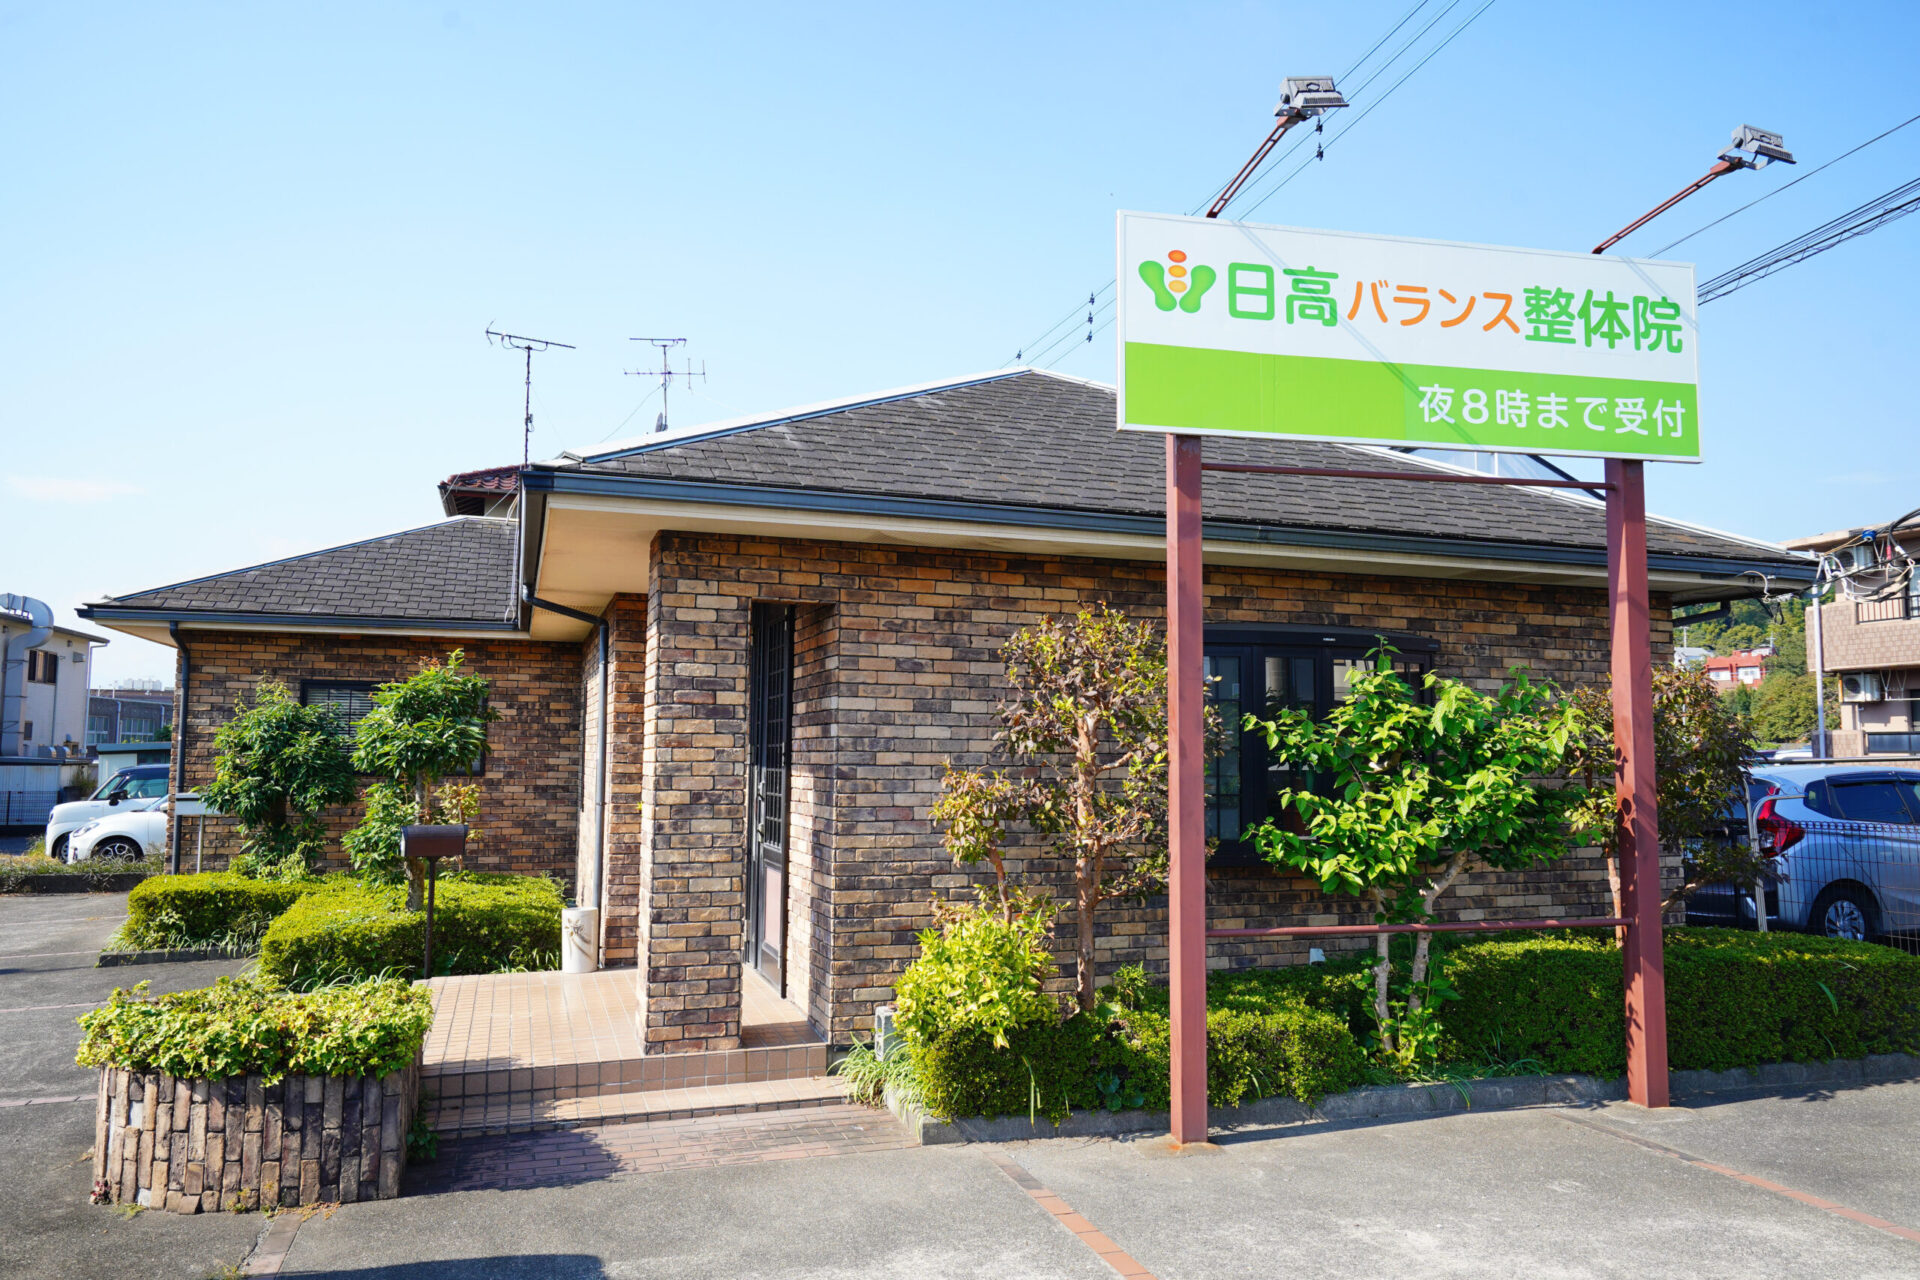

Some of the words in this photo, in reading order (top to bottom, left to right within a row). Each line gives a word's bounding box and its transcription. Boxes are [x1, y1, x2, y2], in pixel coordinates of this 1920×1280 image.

[1228, 262, 1683, 354] 日高バランス整体院
[1418, 383, 1687, 438] 夜8時まで受付
